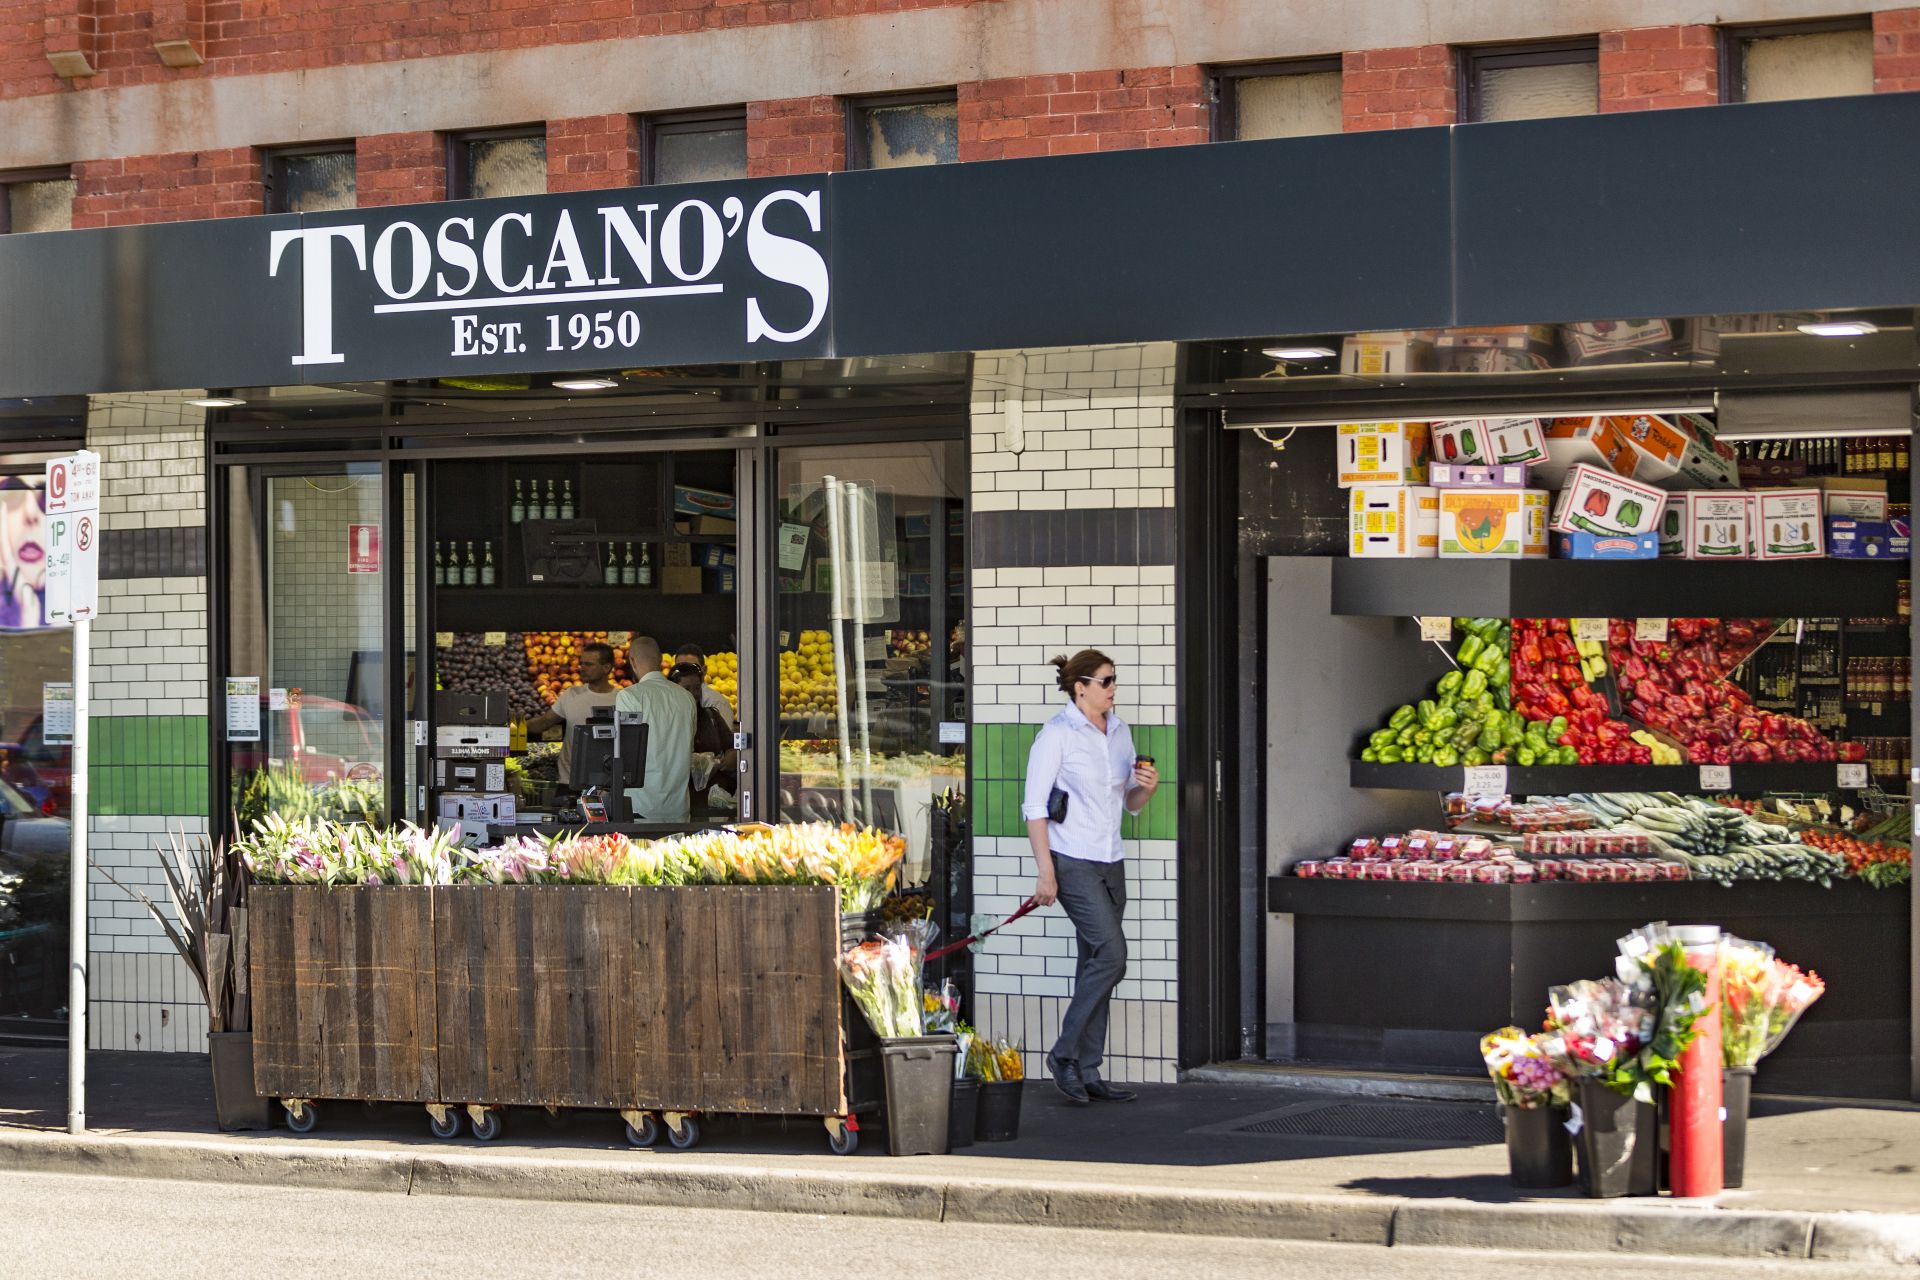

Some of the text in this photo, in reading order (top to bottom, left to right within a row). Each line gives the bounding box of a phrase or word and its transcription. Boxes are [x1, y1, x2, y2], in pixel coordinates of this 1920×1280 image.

[269, 190, 830, 366] TOSCANO'S
[545, 309, 641, 352] 1950
[51, 520, 66, 547] 1P
